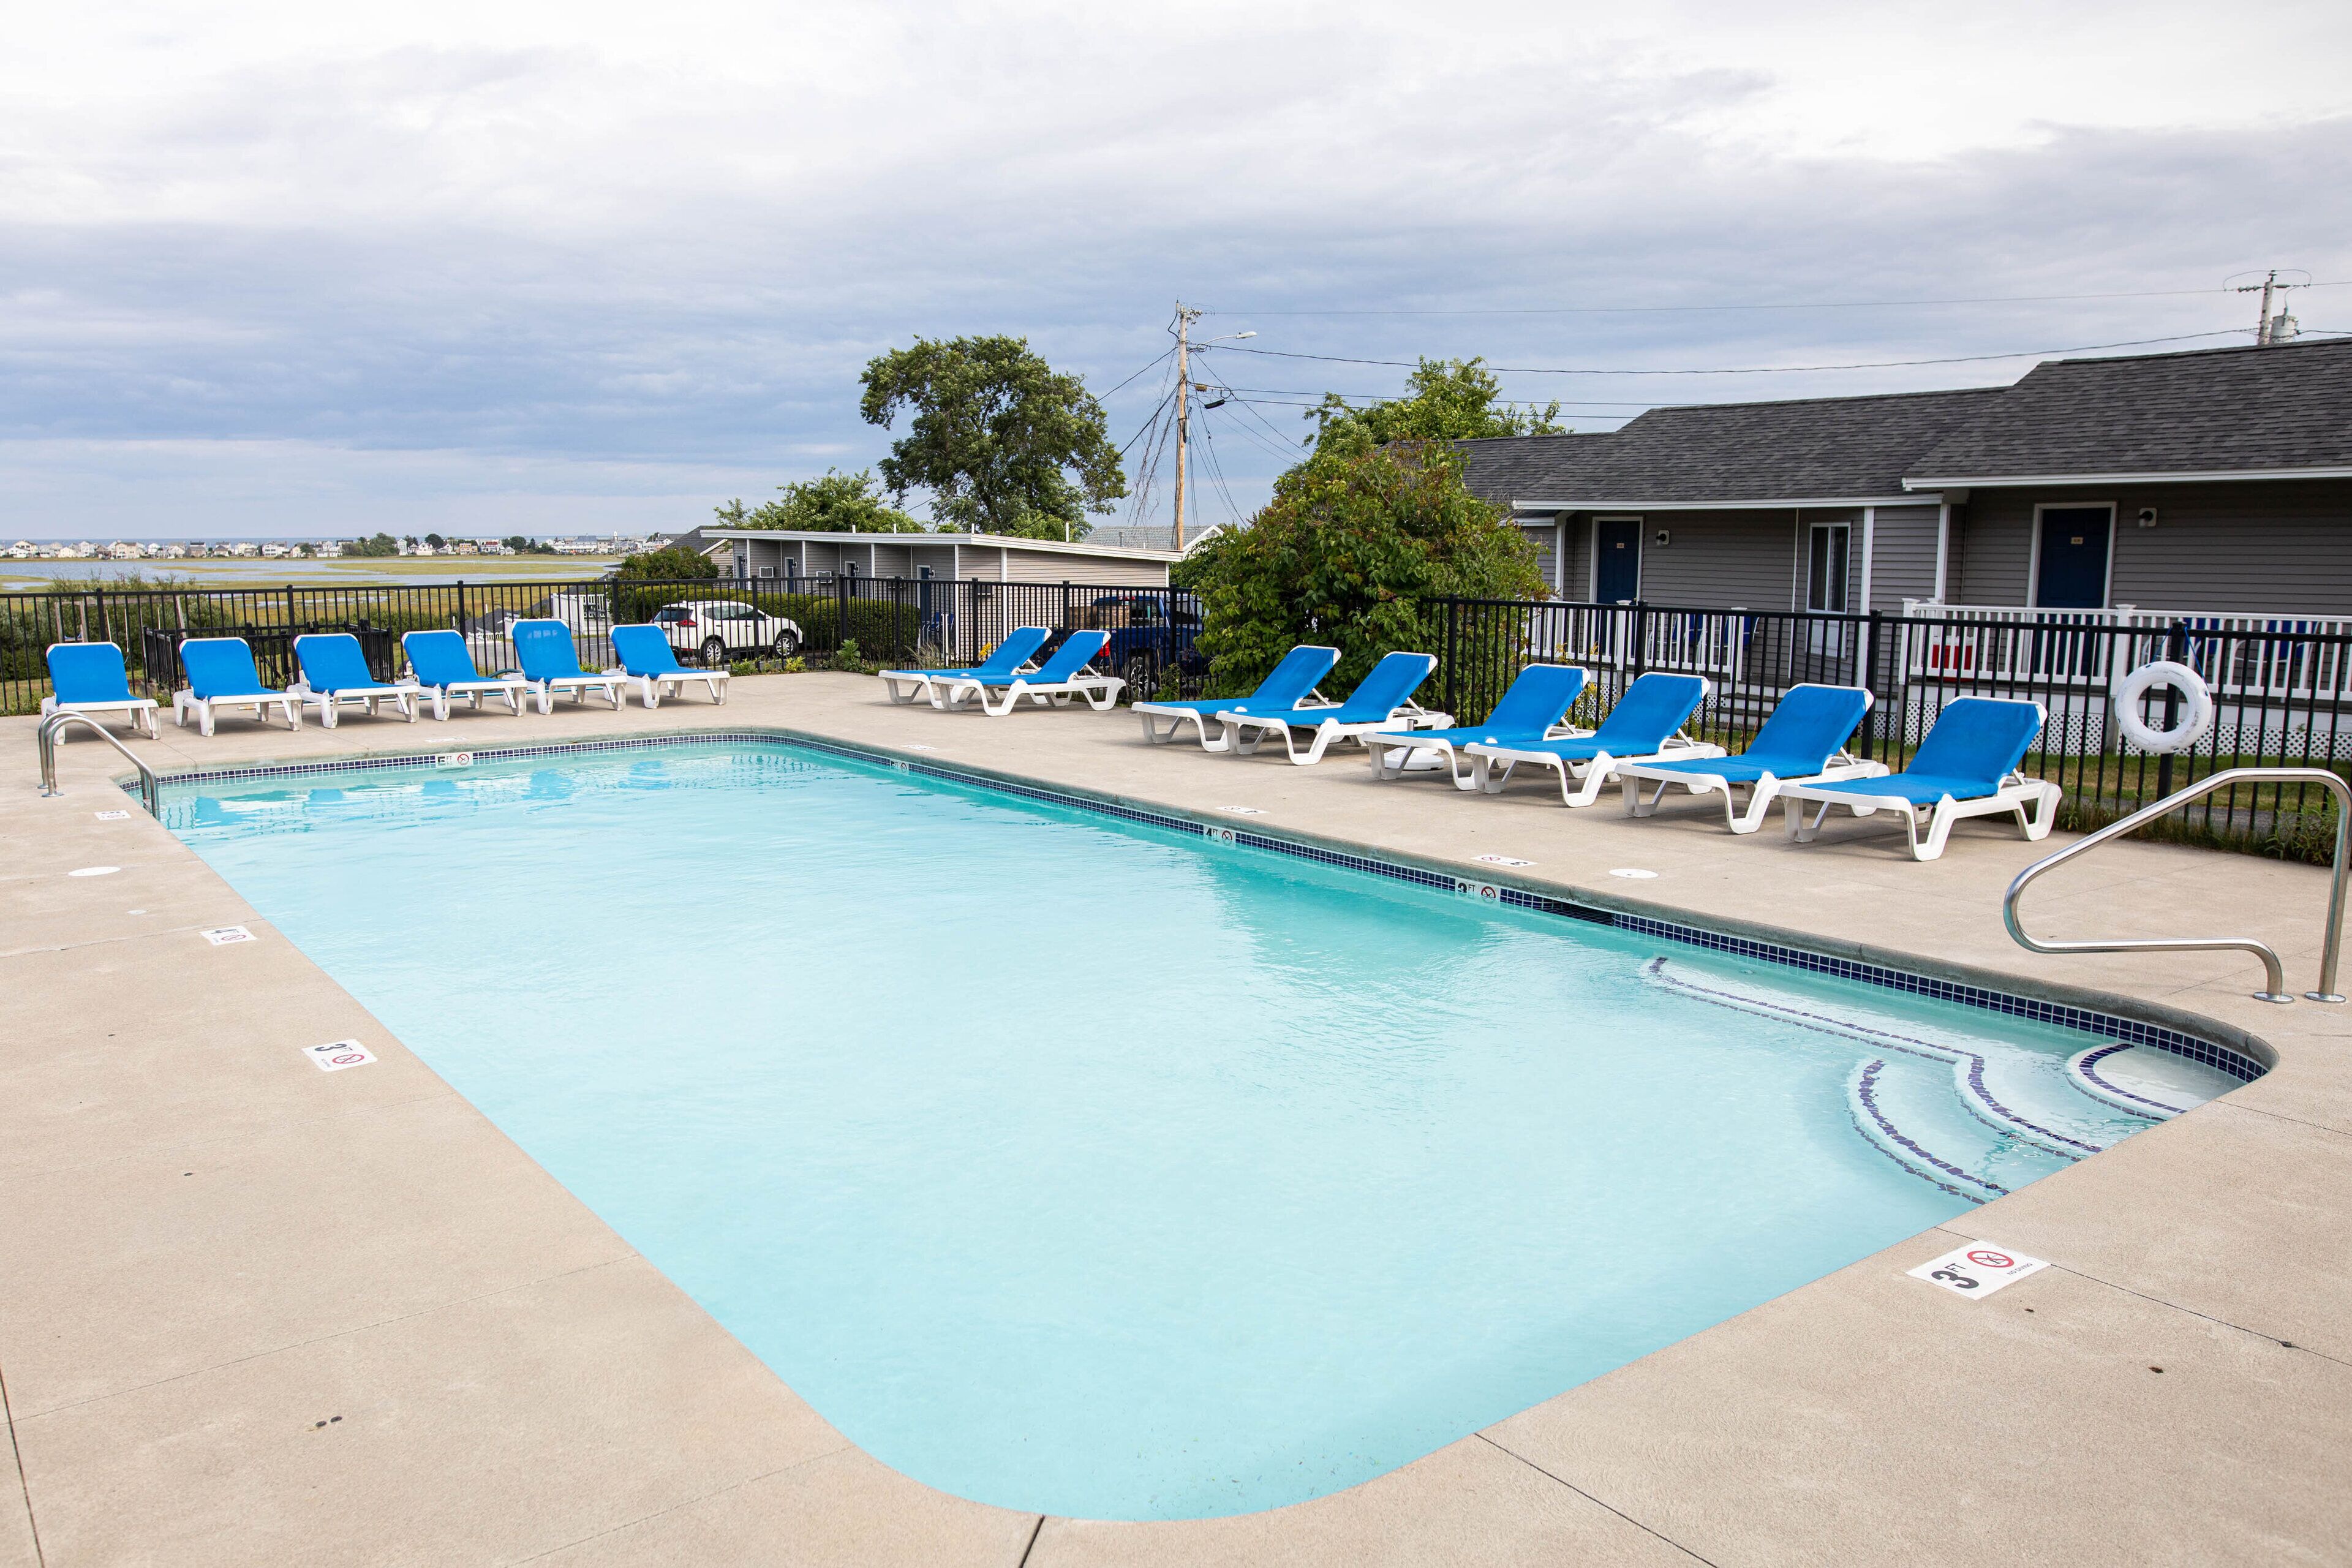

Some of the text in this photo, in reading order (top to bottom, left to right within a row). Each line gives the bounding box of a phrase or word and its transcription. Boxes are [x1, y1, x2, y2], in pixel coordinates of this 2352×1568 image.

[314, 1043, 347, 1052] 3
[2015, 1262, 2033, 1272] DIVING
[1931, 1262, 1980, 1289] 3 FT
